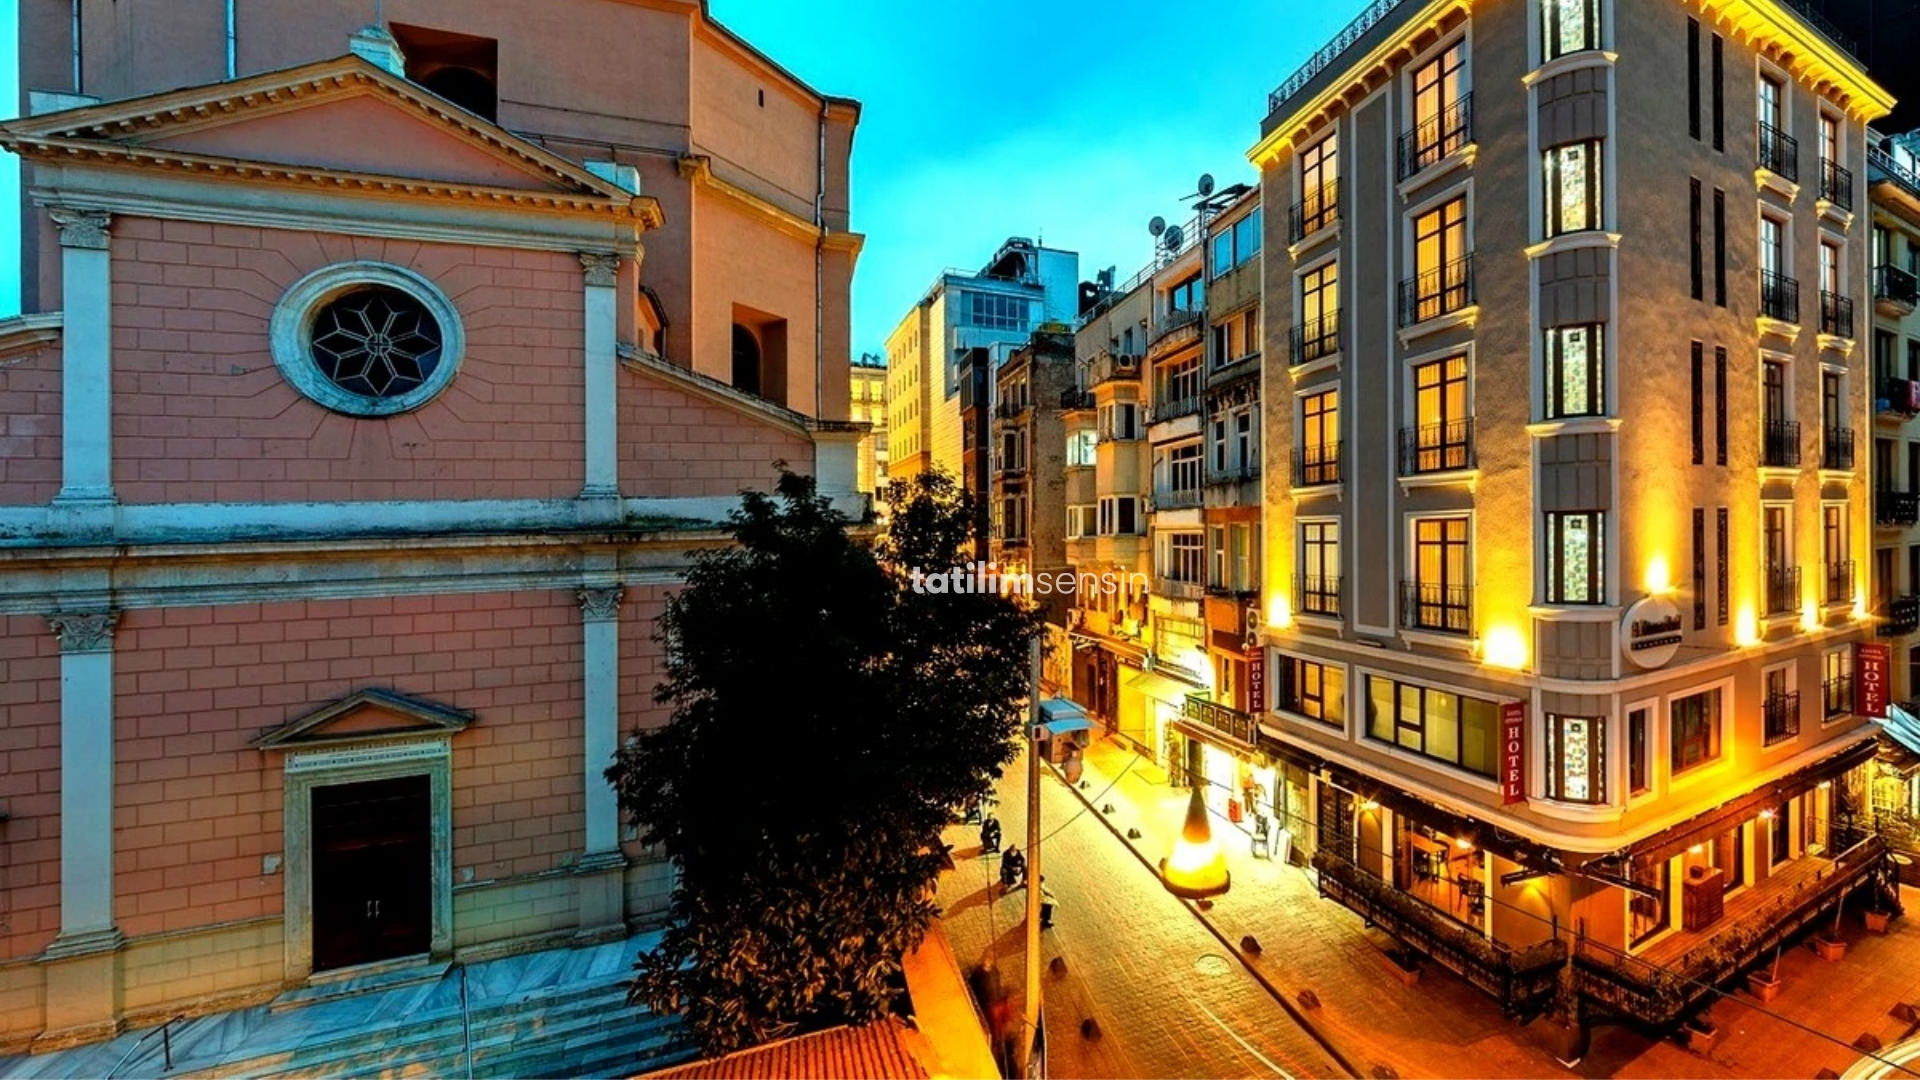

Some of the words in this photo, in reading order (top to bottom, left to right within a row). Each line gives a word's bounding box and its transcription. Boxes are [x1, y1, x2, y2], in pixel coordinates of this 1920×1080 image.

[1251, 662, 1262, 708] HOTEL
[1864, 661, 1880, 712] HOTEL
[1508, 727, 1520, 796] HOTEL
